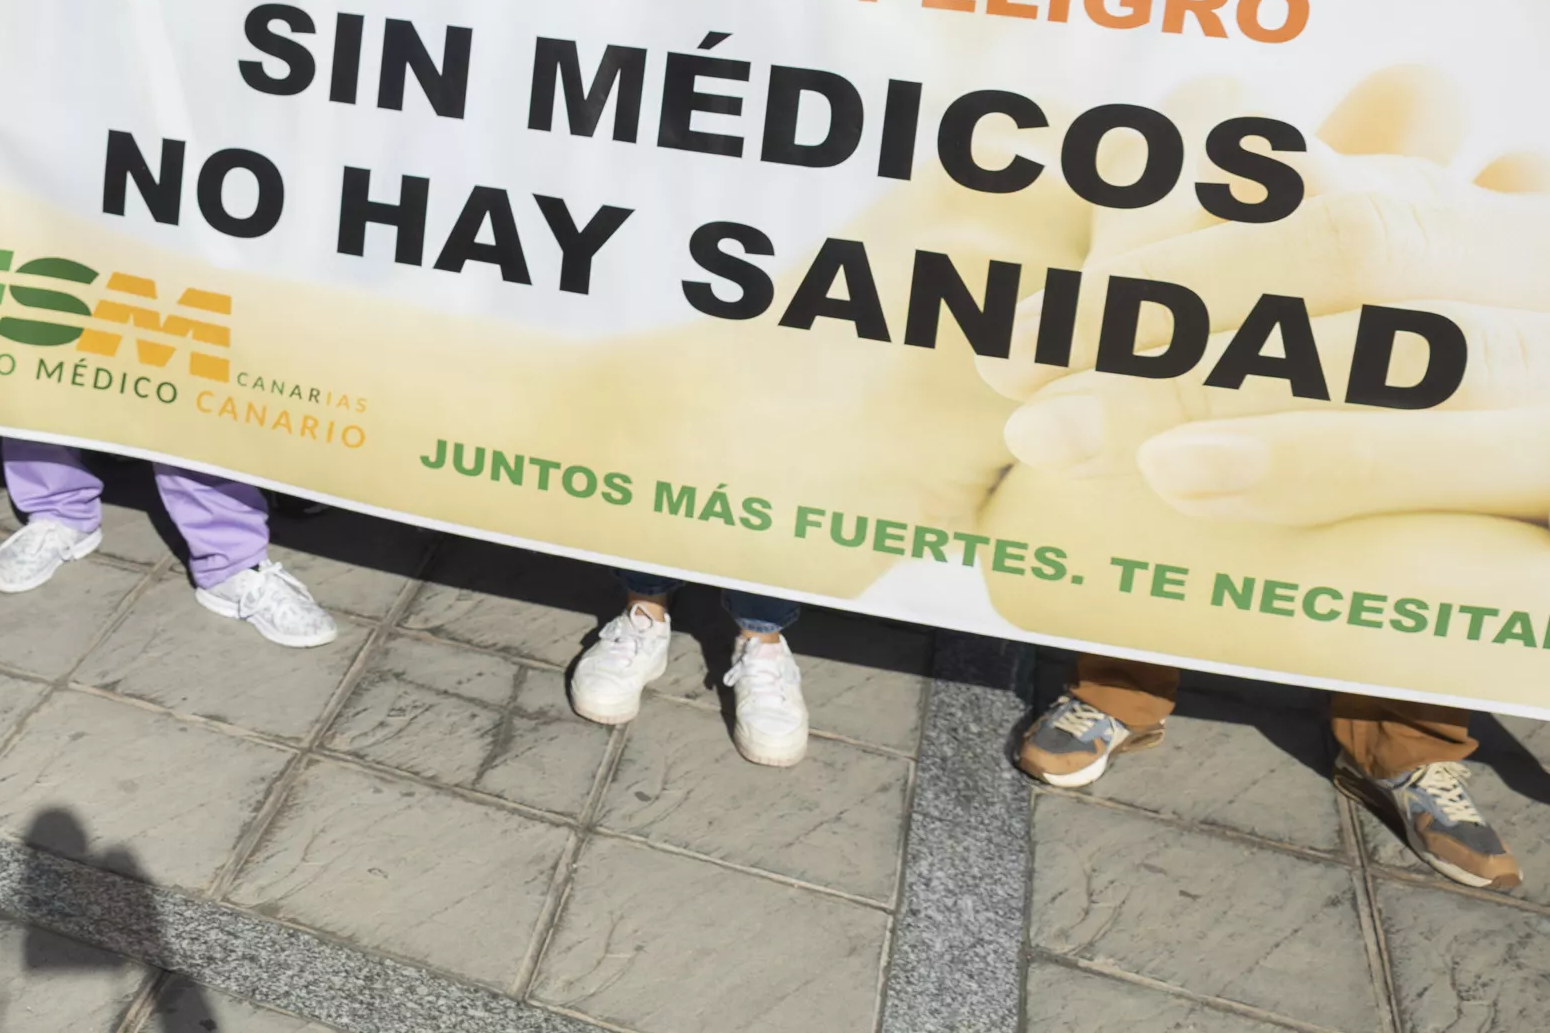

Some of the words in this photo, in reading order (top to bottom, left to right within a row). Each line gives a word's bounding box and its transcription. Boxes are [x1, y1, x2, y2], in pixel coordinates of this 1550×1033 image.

[238, 3, 473, 120] SIN
[527, 31, 1308, 224] MÉDICOS
[102, 129, 285, 239] NO
[337, 165, 635, 295] HAY
[680, 220, 1469, 411] SANIDAD
[35, 358, 179, 406] MÉDICO
[196, 390, 366, 450] CANARIO
[237, 371, 368, 414] CANARIAS
[420, 438, 633, 506] JUNTOS
[653, 481, 773, 532] MÁS
[793, 505, 1085, 585] FUERTES.
[1110, 556, 1190, 602] TE
[1210, 572, 1550, 650] NECESITA
